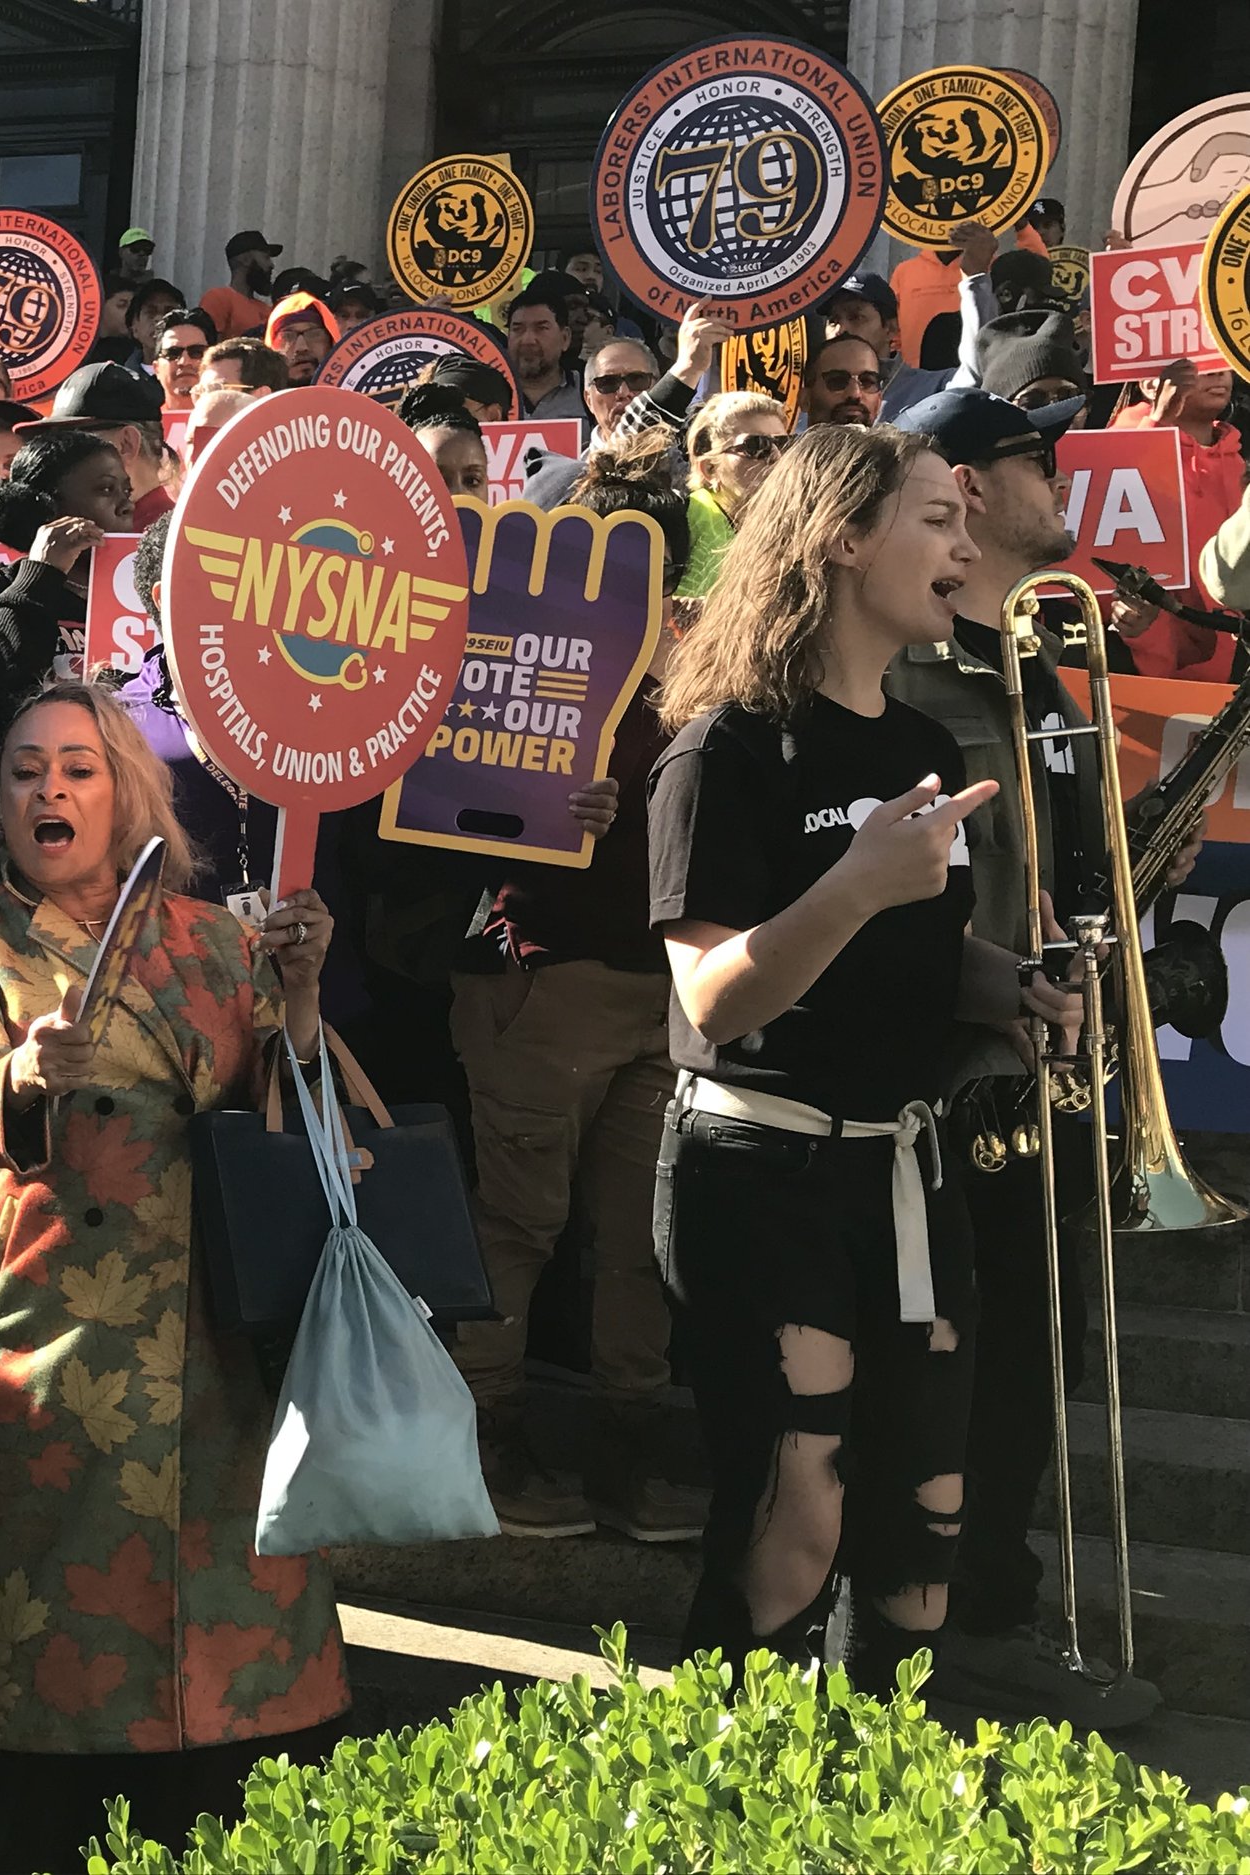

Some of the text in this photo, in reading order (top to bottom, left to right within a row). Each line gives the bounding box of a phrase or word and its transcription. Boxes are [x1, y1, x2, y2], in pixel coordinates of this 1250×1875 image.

[883, 105, 908, 139] NION
[913, 86, 936, 103] ONE
[941, 78, 987, 96] FAMILY
[994, 91, 1019, 116] ONE
[1010, 111, 1036, 144] FIGHT
[602, 48, 877, 243] LABORERS' INTERNATIONAL UNION
[632, 81, 843, 210] JUSTICE HONOR STRENGTH
[398, 165, 525, 232] ONE UNION ONE FAMILY ONE FIGHT
[655, 130, 822, 254] 79
[891, 205, 946, 237] LOCALS
[993, 171, 1029, 216] UNION
[940, 172, 984, 194] DC9
[402, 254, 413, 270] 16
[456, 285, 483, 300] ONE
[483, 252, 516, 290] UNION
[447, 249, 483, 263] DC9
[1221, 233, 1250, 268] ONE
[5, 237, 47, 257] HONOR
[59, 271, 77, 333] STRENGTH
[647, 257, 843, 324] of Nrth America
[668, 265, 732, 292] Organized
[737, 275, 769, 292] April
[72, 300, 96, 354] UNION
[345, 316, 487, 357] INTERNATIONAL
[1114, 307, 1217, 360] STR
[1227, 307, 1248, 332] 16
[375, 340, 423, 359] HONOR
[17, 380, 46, 396] rica
[216, 414, 450, 558] DEFENDING OUR PATIENTS,
[232, 536, 411, 654] NYSNA
[465, 633, 593, 671] 9SEIU OUR
[457, 659, 534, 697] OTE
[199, 624, 444, 785] HOSPITALS, UNION & PRACTICE
[503, 699, 582, 738] OUR
[424, 725, 576, 775] POWER
